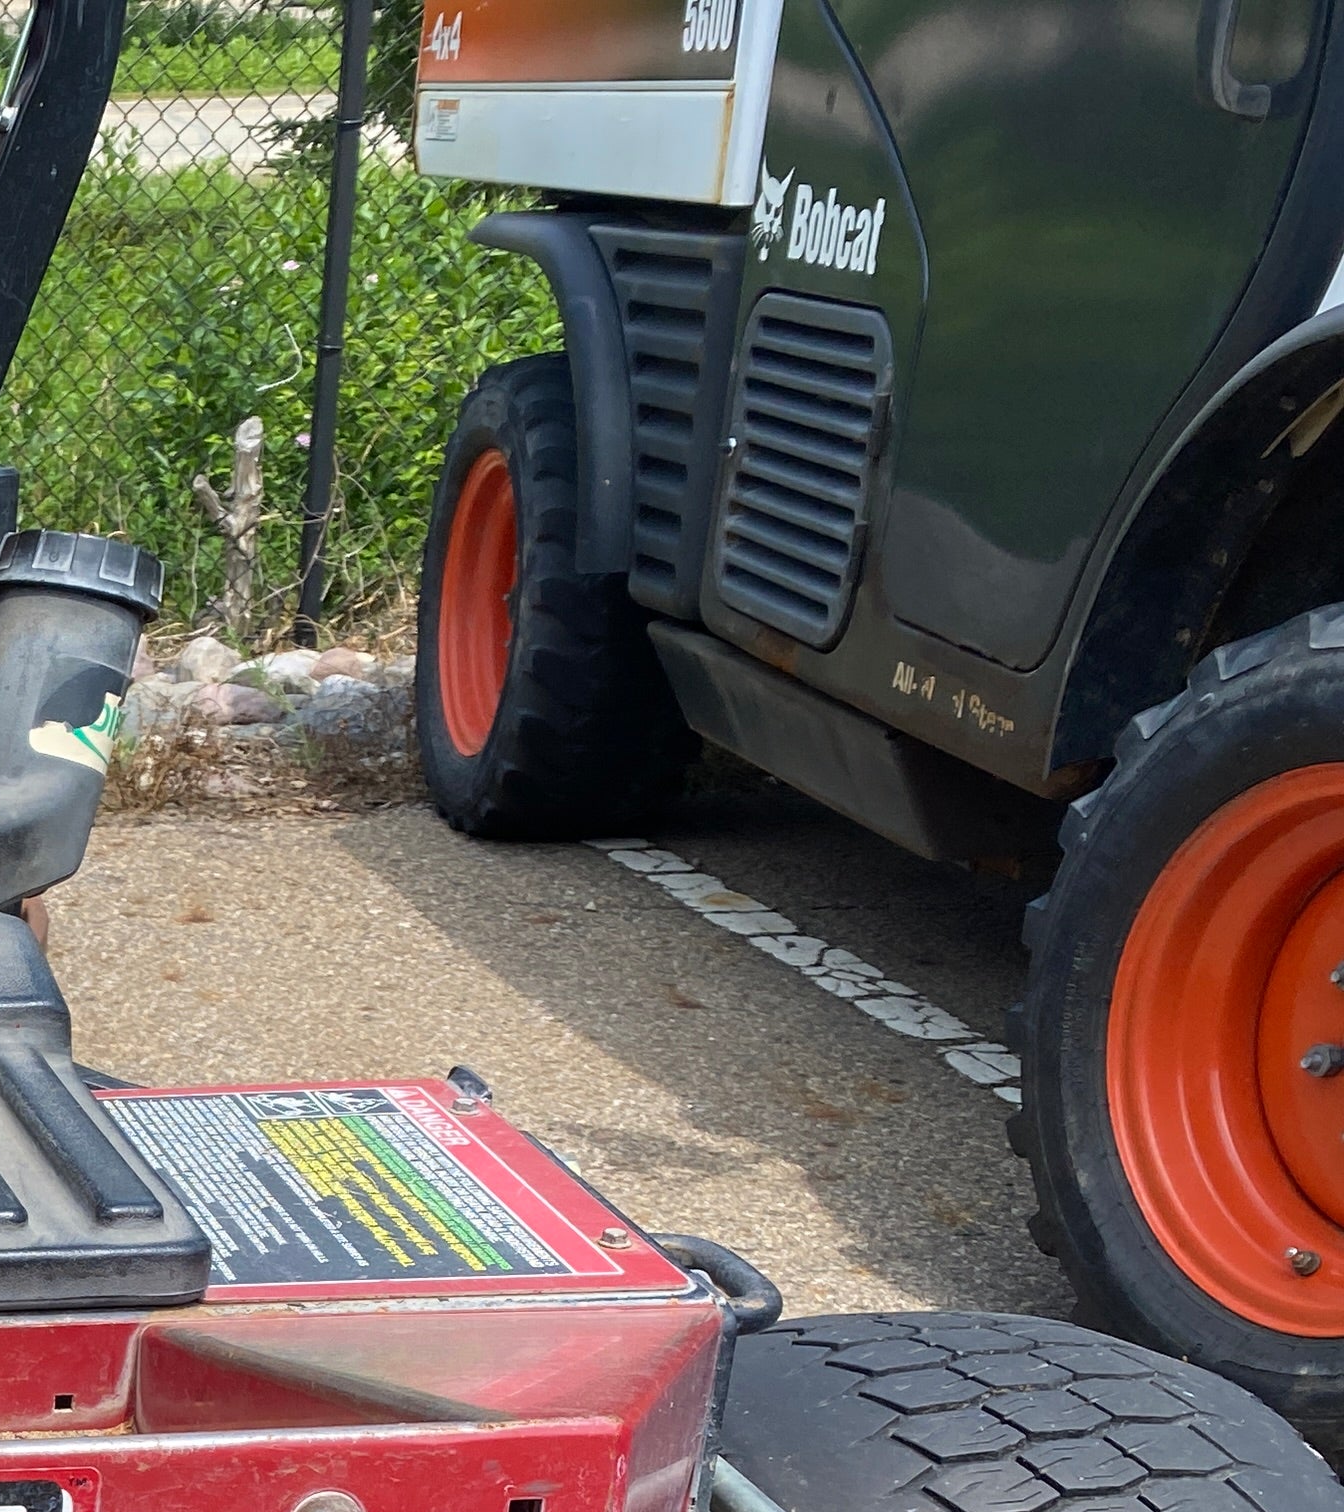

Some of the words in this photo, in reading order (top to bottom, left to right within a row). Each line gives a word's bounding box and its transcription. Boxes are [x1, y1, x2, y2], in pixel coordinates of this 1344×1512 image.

[423, 11, 463, 61] 4x4
[682, 0, 737, 52] 5600
[787, 184, 887, 275] Bobcat
[400, 1097, 472, 1147] DANGER
